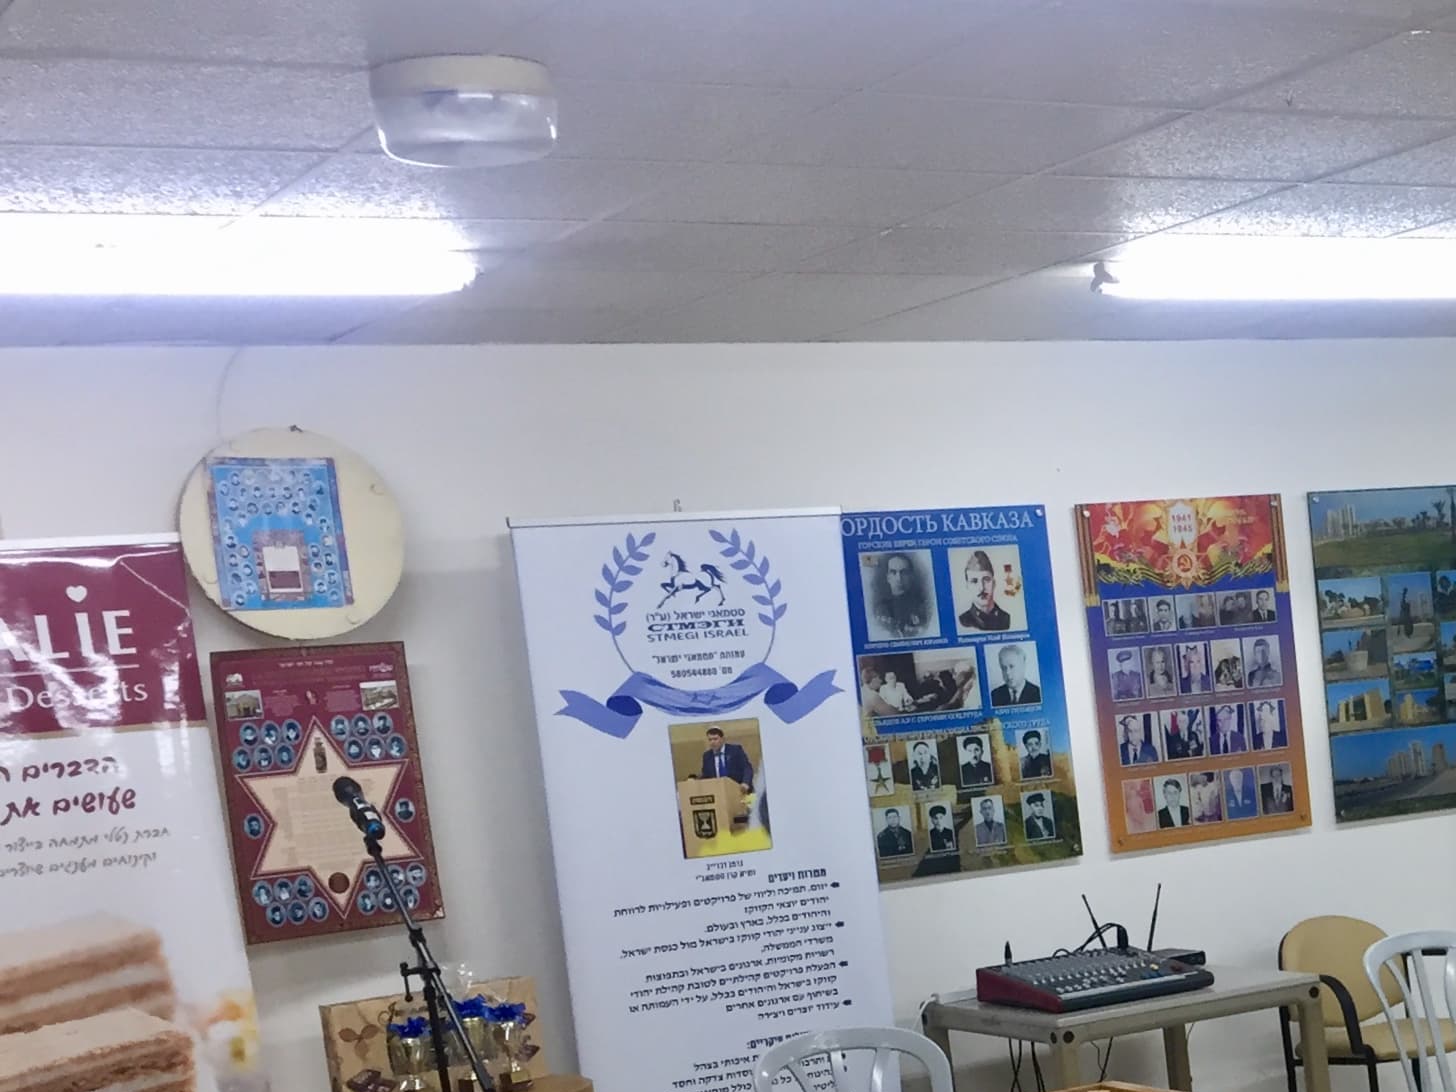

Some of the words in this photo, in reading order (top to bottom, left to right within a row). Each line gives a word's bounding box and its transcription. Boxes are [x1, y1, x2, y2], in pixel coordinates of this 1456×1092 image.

[1171, 513, 1193, 524] 1941
[841, 516, 938, 539] ОРДОСТЬ
[941, 511, 1035, 532] КАВКАЗА
[1173, 523, 1194, 533] 1945
[673, 610, 705, 620] ישראל
[648, 619, 745, 632] СТМЭГИ
[647, 631, 699, 643] STMEGI
[704, 628, 749, 639] ISRAEL
[52, 786, 137, 816] שעושים
[0, 797, 40, 826] את
[738, 892, 752, 900] של
[779, 885, 806, 895] תמיכה
[648, 899, 691, 912] ופעילויות
[693, 894, 736, 907] פרויקטים
[776, 900, 798, 909] יוצאי
[800, 896, 830, 906] יהודים
[614, 905, 646, 917] לרווחת
[744, 902, 774, 914] הקווקז
[792, 910, 831, 920] והיהודים
[741, 917, 764, 929] בארץ
[811, 922, 832, 932] ייצוג
[737, 932, 760, 943] קווקז
[763, 928, 784, 938] יהודי
[680, 940, 697, 950] מול
[699, 935, 735, 948] בישראל
[804, 936, 834, 945] משרדי
[653, 943, 678, 954] כנסת
[690, 964, 727, 976] בישראל
[728, 959, 762, 971] ארגונים
[805, 961, 836, 973] הפעלת
[645, 969, 689, 983] ובתפוצות
[763, 966, 804, 979] פרויקטים
[687, 978, 717, 991] לטובת
[719, 972, 761, 986] קהילתיים
[778, 978, 812, 990] בישראל
[813, 975, 837, 986] קווקז
[630, 989, 653, 999] יהודי
[655, 983, 685, 995] קהילת
[737, 984, 777, 997] והיהודים
[806, 988, 839, 1001] בשיתוף
[695, 994, 708, 1003] על
[757, 996, 791, 1008] ארגונים
[792, 994, 805, 1002] עם
[628, 1004, 640, 1013] או
[641, 999, 679, 1012] העמותה
[725, 1001, 755, 1013] אחרים
[816, 1001, 840, 1011] עידוד
[720, 1055, 750, 1067] איכותי
[698, 1074, 723, 1086] צדקה
[726, 1069, 753, 1080] וסדות
[672, 1078, 696, 1089] וחסד
[731, 1082, 752, 1092] כולל
